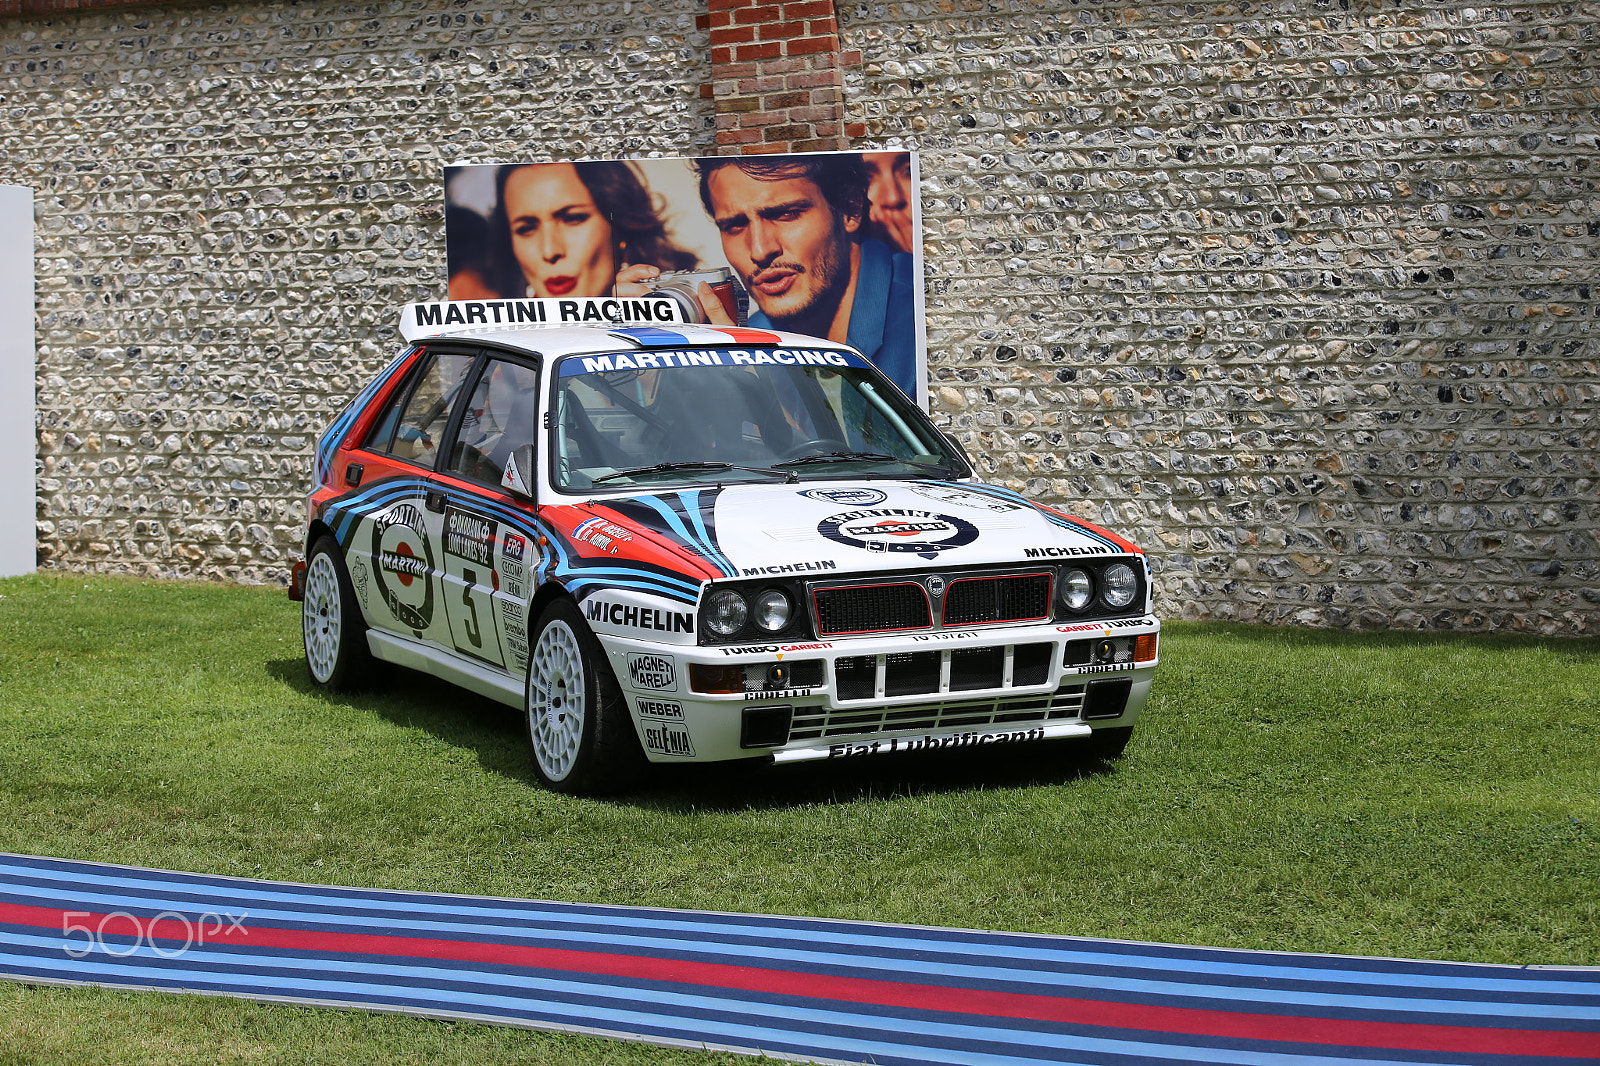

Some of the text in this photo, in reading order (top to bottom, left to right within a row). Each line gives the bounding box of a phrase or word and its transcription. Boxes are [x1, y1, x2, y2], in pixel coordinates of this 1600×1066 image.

[415, 299, 674, 326] MARTINI RACING
[582, 349, 849, 373] MARTINI RACING
[376, 505, 428, 546] SPORTLINE
[825, 509, 942, 524] SPORTLINE
[849, 522, 947, 535] MARTINI
[448, 532, 461, 554] 1000
[461, 537, 478, 561] LAKES
[506, 537, 521, 556] ERG
[1024, 546, 1107, 557] MICHELIN
[384, 553, 426, 577] MARTINI
[742, 560, 836, 576] MICHELIN
[463, 567, 482, 649] 5
[586, 600, 695, 633] MICHELIN
[1056, 618, 1154, 633] GARRETT TURBO
[719, 642, 833, 656] TURBO GARRETT
[630, 656, 674, 682] MAGNETI
[638, 700, 682, 717] WEBER
